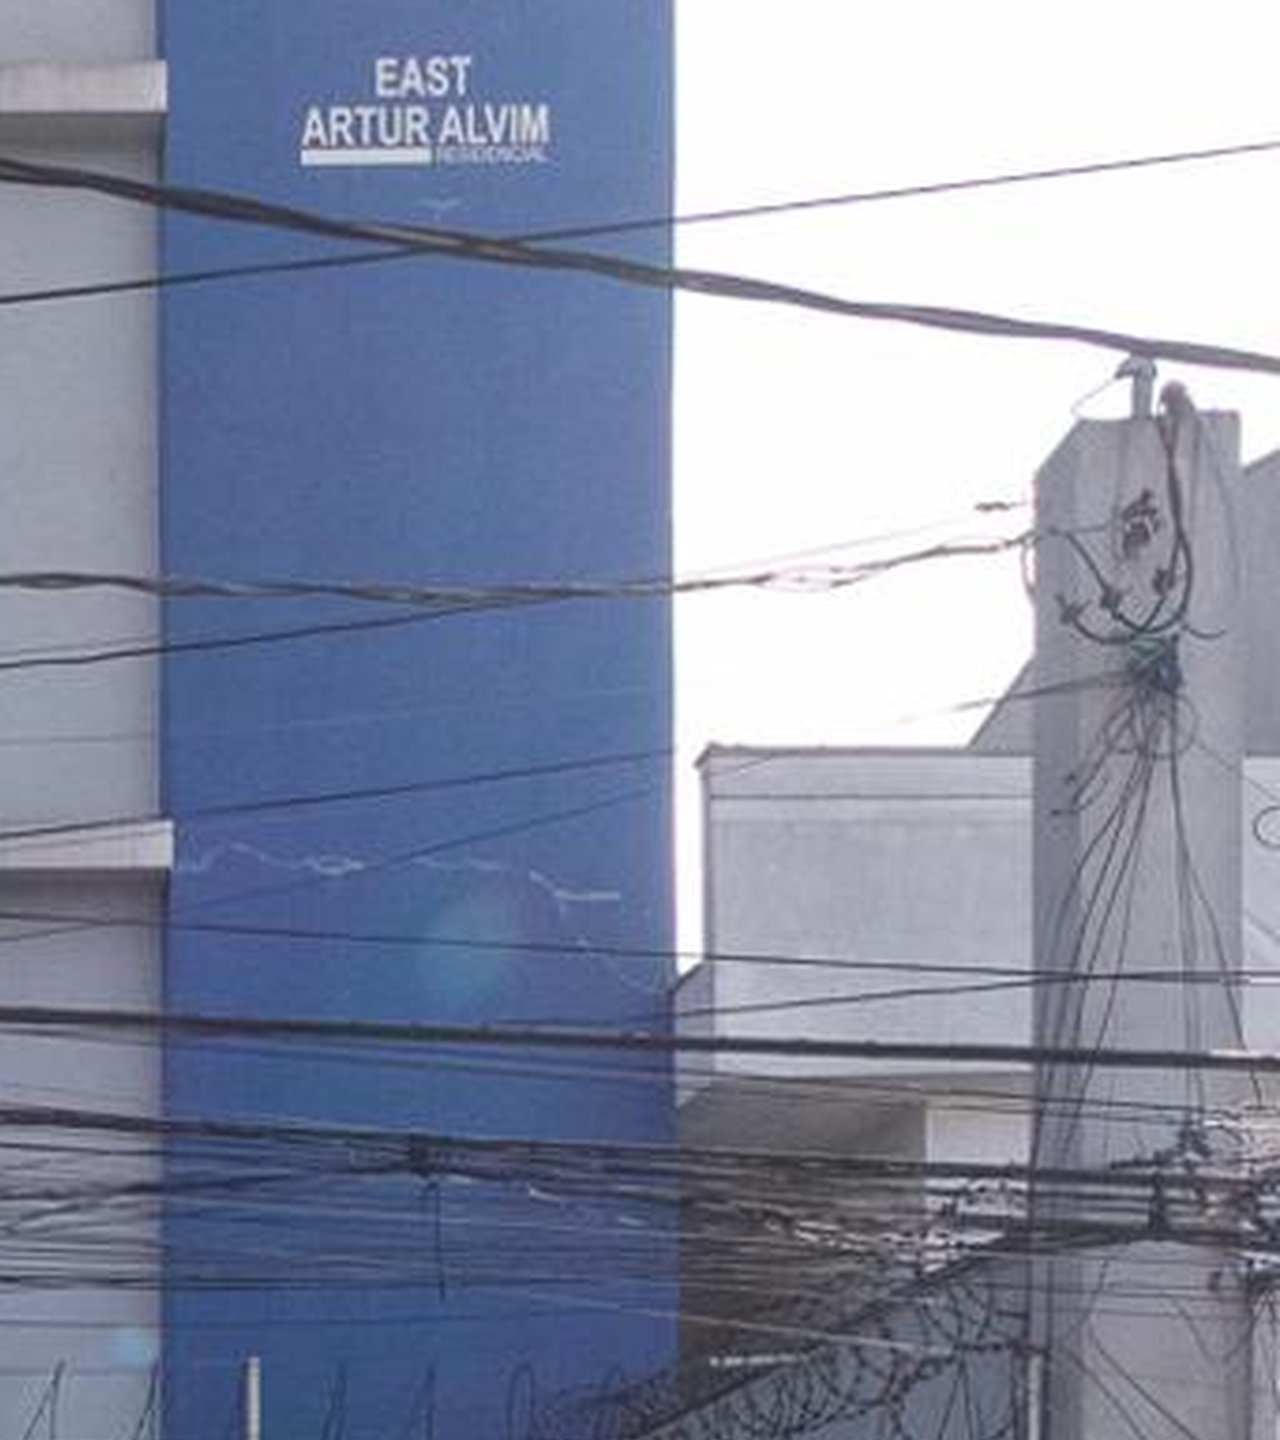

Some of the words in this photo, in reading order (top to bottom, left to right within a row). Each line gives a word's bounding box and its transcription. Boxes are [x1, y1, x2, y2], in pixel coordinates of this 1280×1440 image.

[375, 56, 472, 97] EAST
[301, 107, 431, 146] ARTUR
[438, 104, 550, 144] ALVIM
